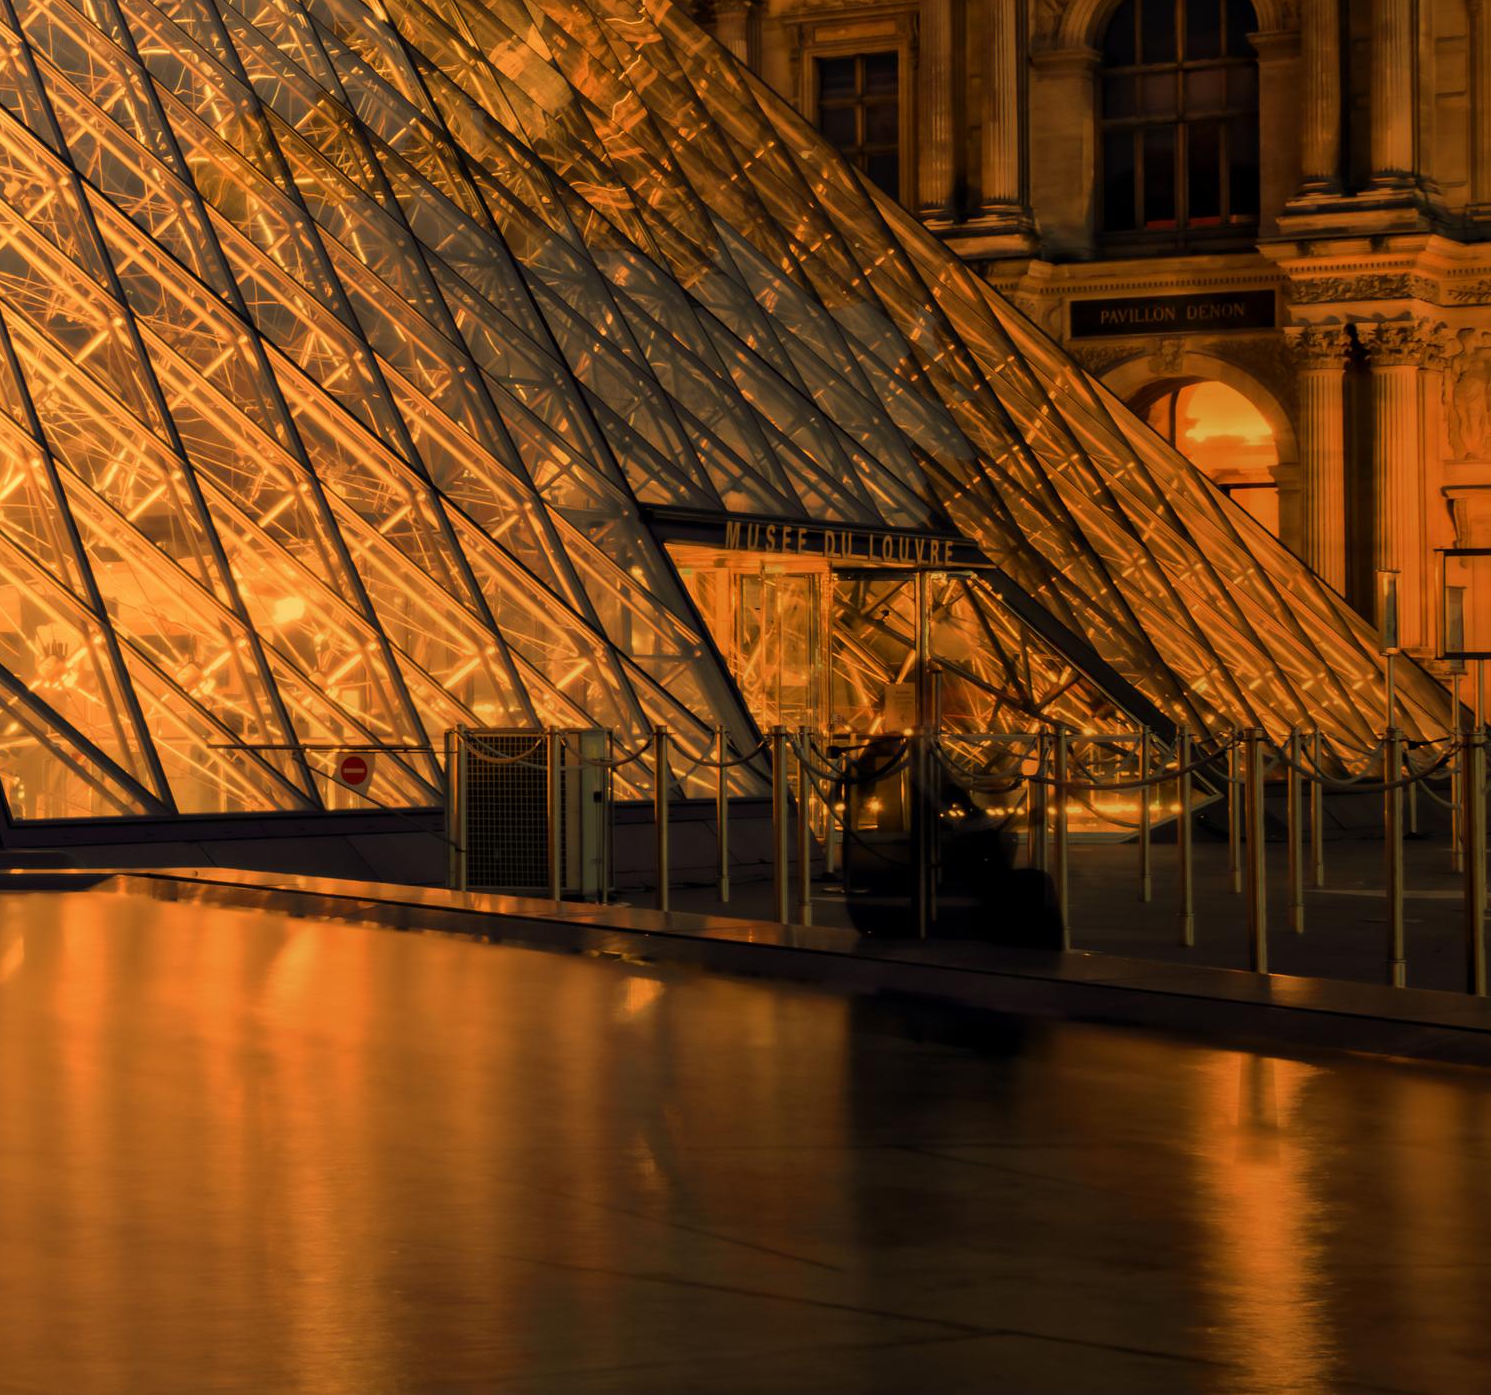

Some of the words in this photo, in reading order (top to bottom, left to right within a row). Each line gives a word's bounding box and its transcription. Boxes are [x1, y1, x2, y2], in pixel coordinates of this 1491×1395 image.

[1100, 305, 1176, 324] PAVILLON
[1186, 301, 1245, 320] DENON
[824, 529, 853, 559] DU
[868, 533, 955, 566] LOUVRE
